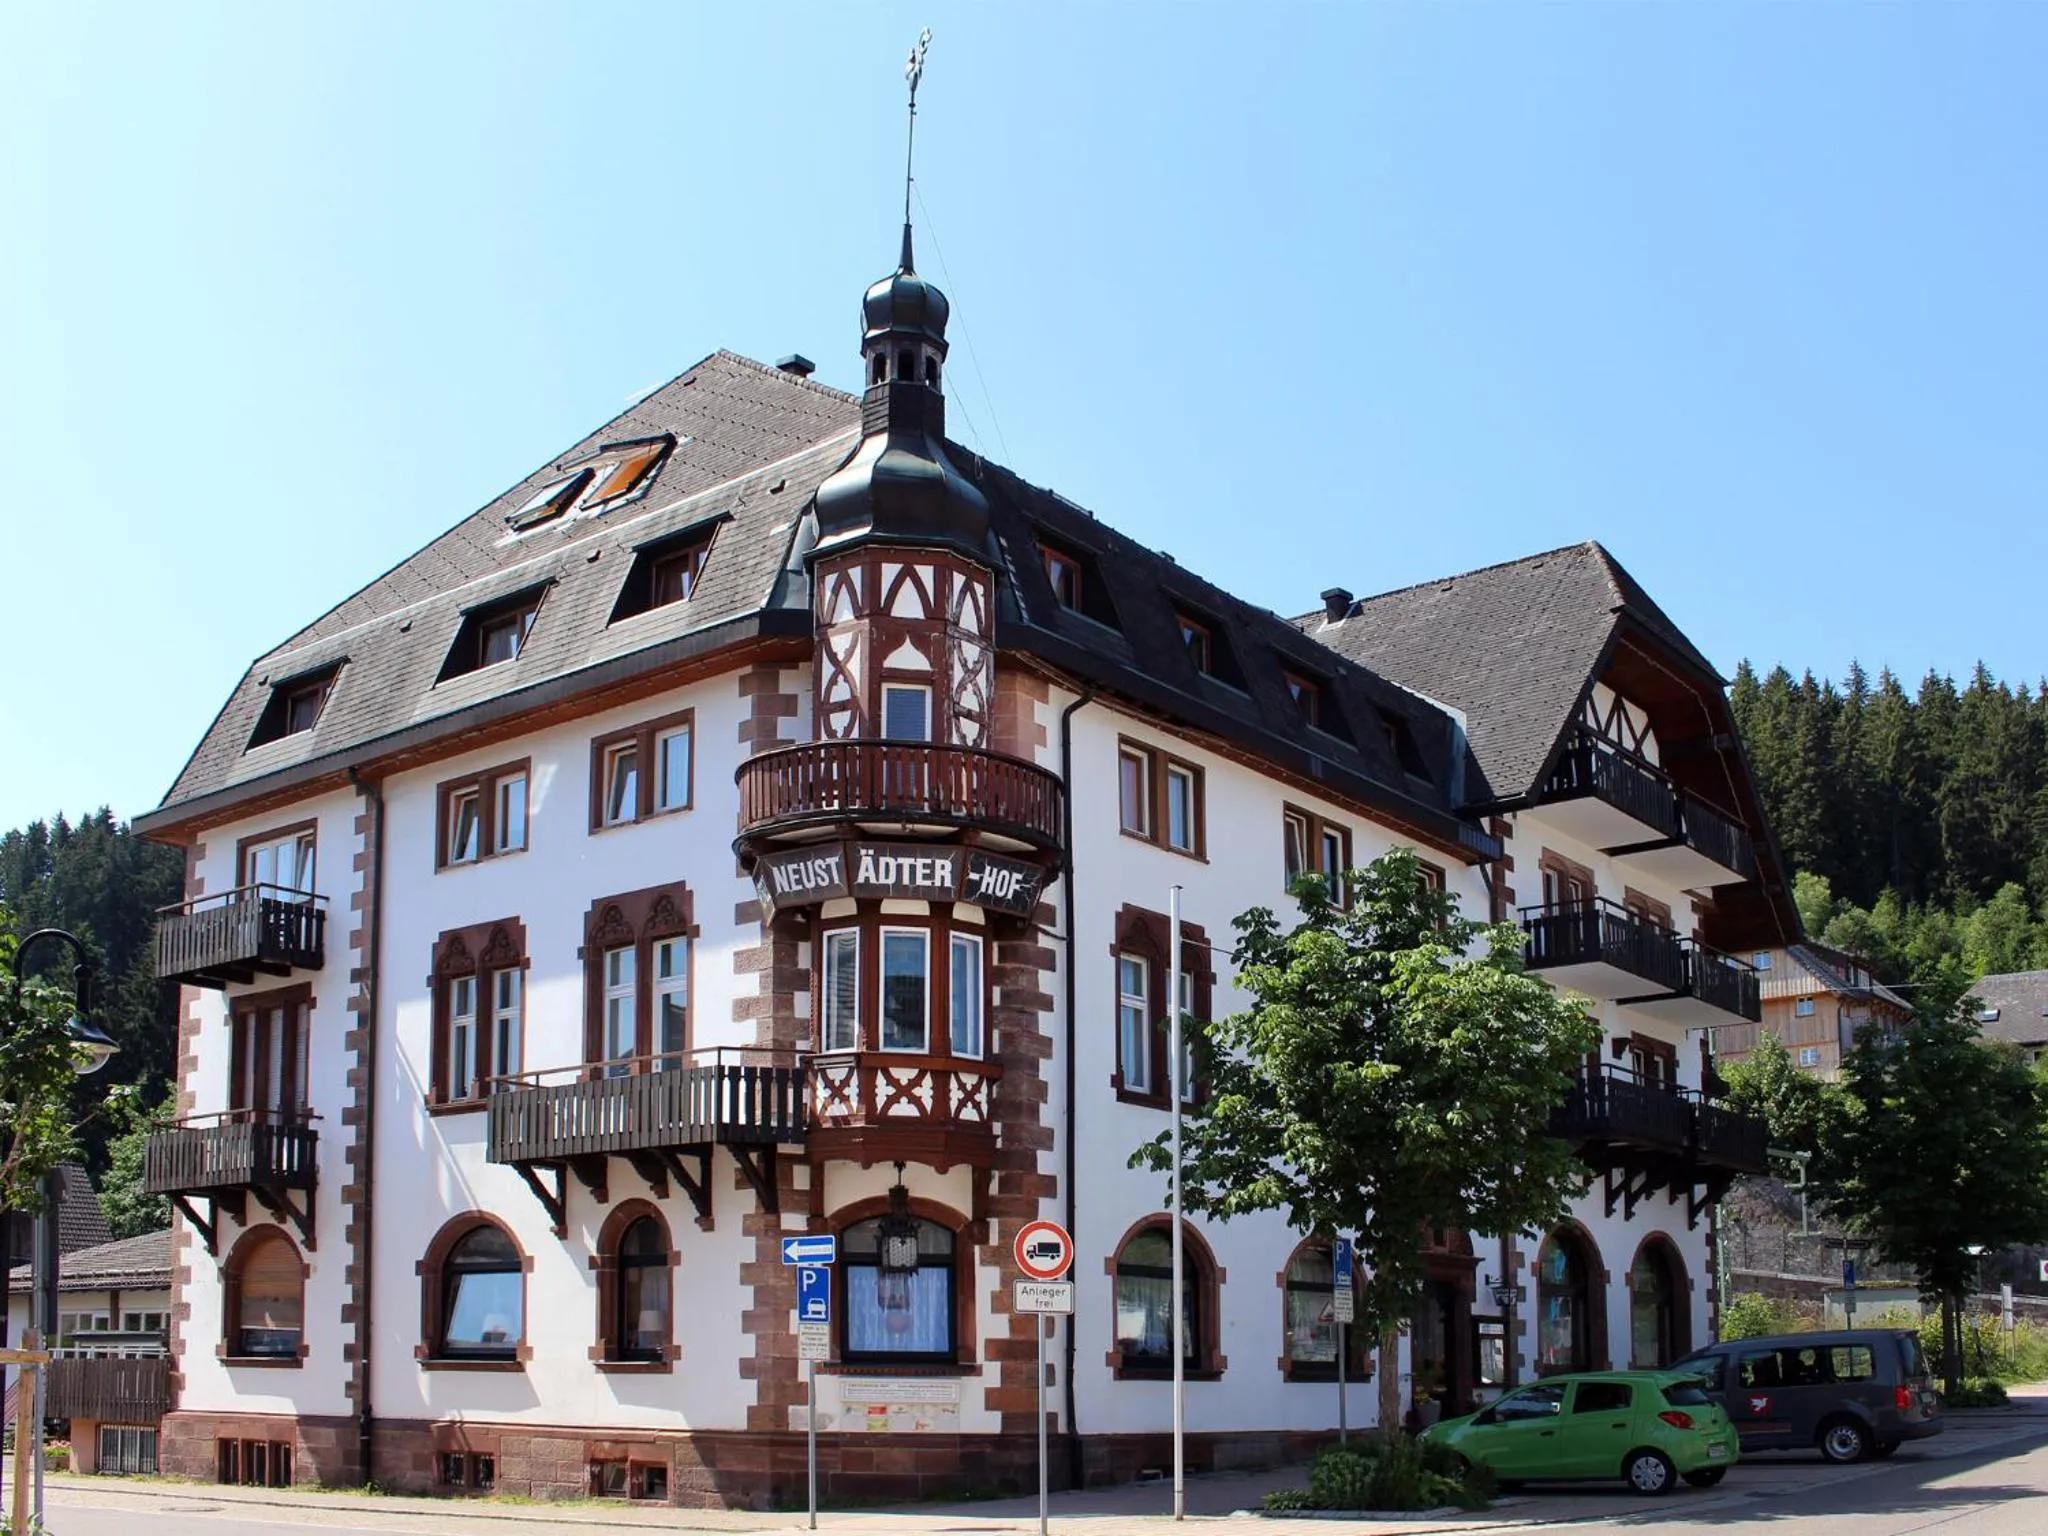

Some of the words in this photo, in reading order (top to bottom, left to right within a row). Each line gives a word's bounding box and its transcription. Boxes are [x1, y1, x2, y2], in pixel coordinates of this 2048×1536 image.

[1336, 1241, 1345, 1261] P
[803, 1270, 817, 1292] P
[1021, 1286, 1066, 1299] Anlieger
[1035, 1298, 1054, 1308] frei
